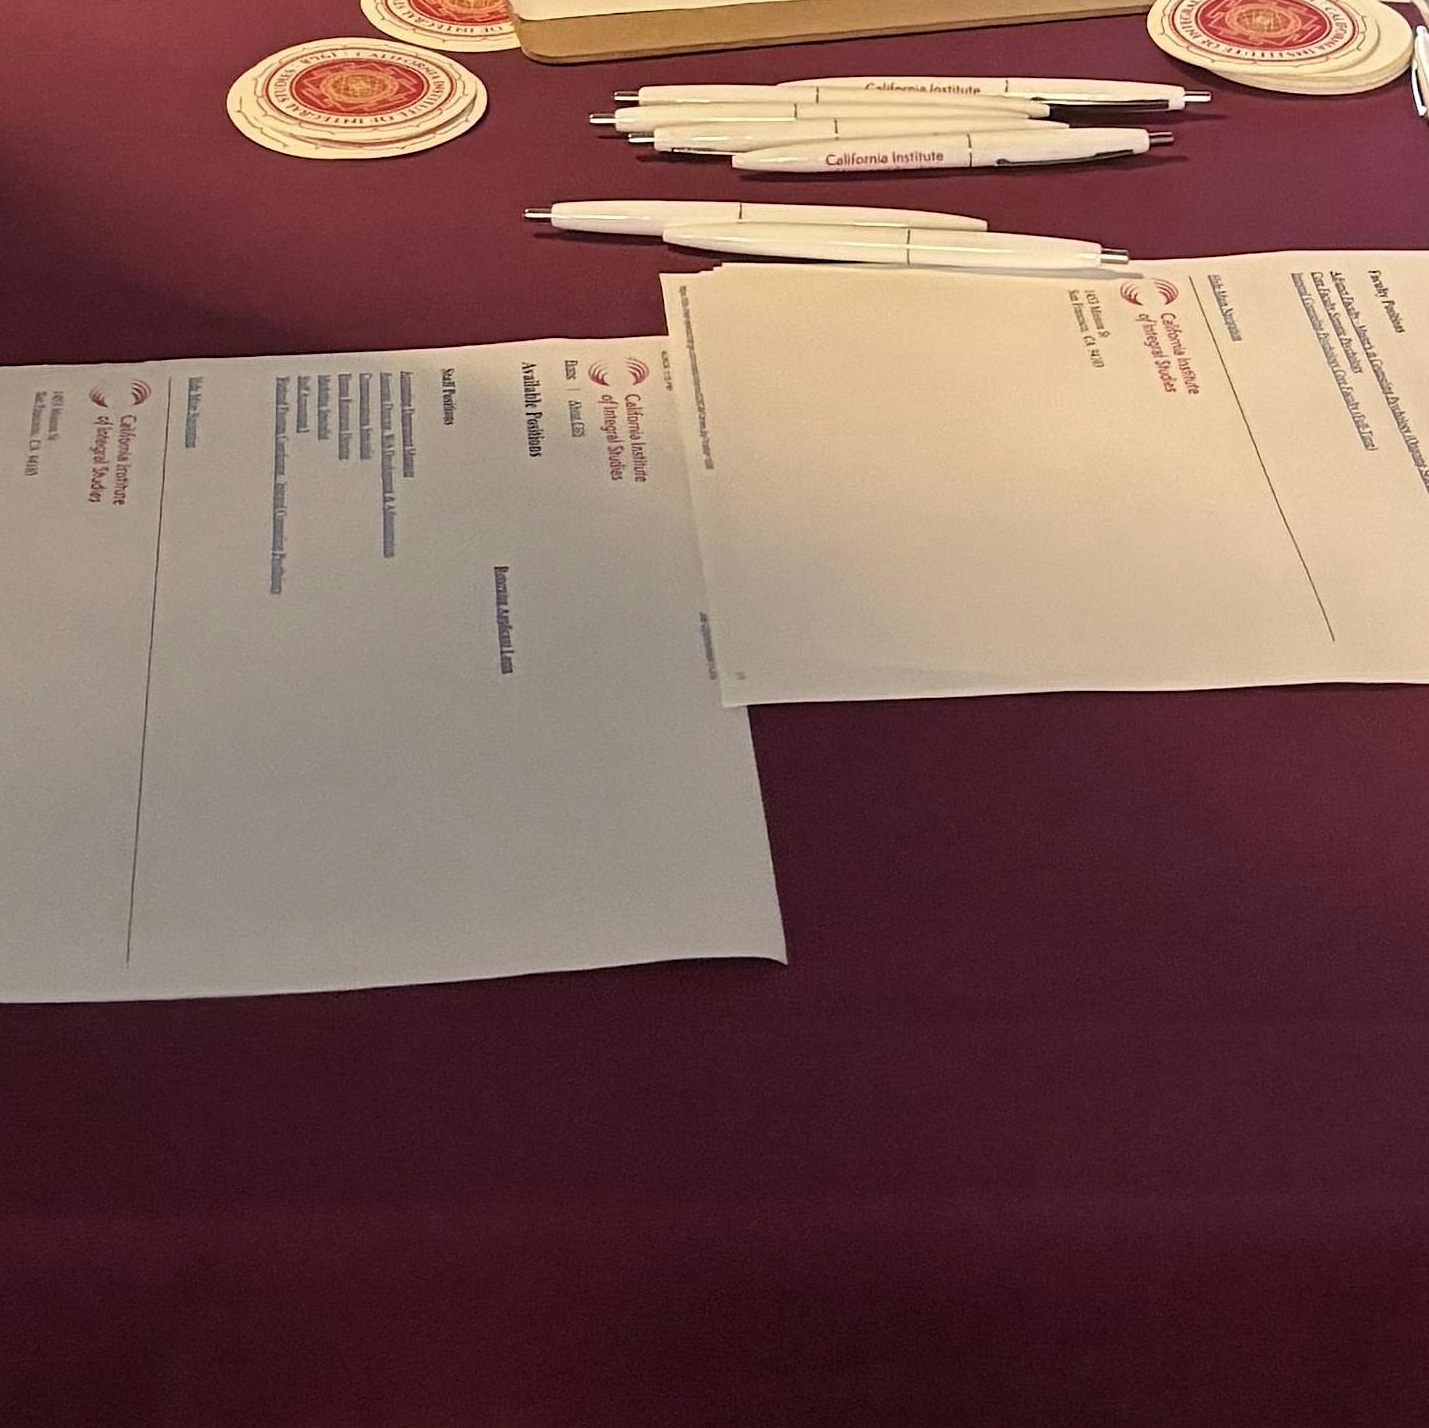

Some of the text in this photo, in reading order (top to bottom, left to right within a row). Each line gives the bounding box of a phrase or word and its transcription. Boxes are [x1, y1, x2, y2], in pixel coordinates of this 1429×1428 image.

[272, 67, 296, 104] STUDIES
[826, 151, 945, 167] California Institute
[1082, 334, 1096, 347] CA
[1366, 267, 1406, 334] Faculty Positions
[1134, 311, 1179, 394] of Integral Studies
[1159, 310, 1200, 395] California Institute
[440, 367, 457, 426] Staff Positions
[520, 360, 546, 458] Available Positions
[597, 393, 627, 481] of Integral Studies
[623, 392, 650, 483] California Institute
[88, 415, 114, 503] of Integral Studies
[113, 413, 136, 506] California Institute
